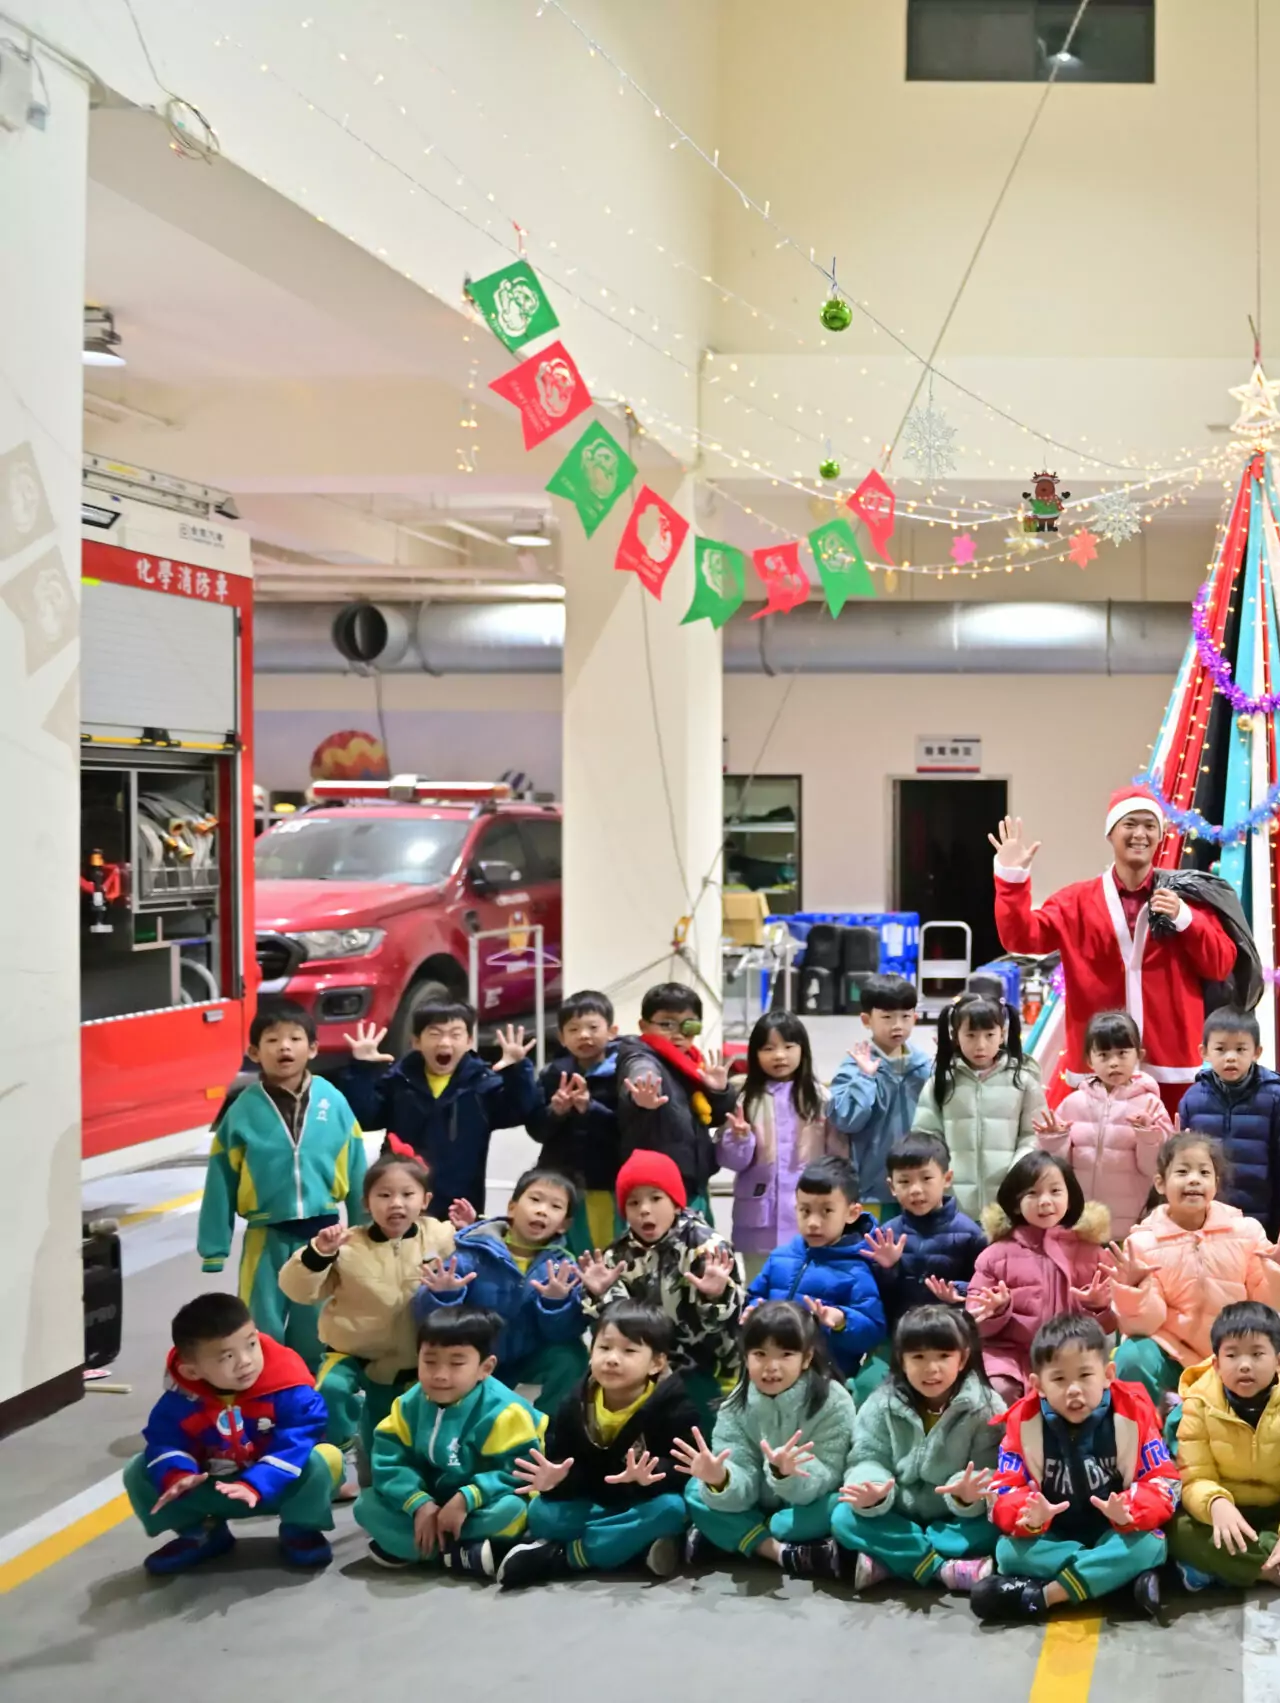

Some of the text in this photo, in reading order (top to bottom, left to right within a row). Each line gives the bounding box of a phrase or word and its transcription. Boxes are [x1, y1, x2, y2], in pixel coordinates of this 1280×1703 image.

[136, 557, 229, 603] 化學消防車
